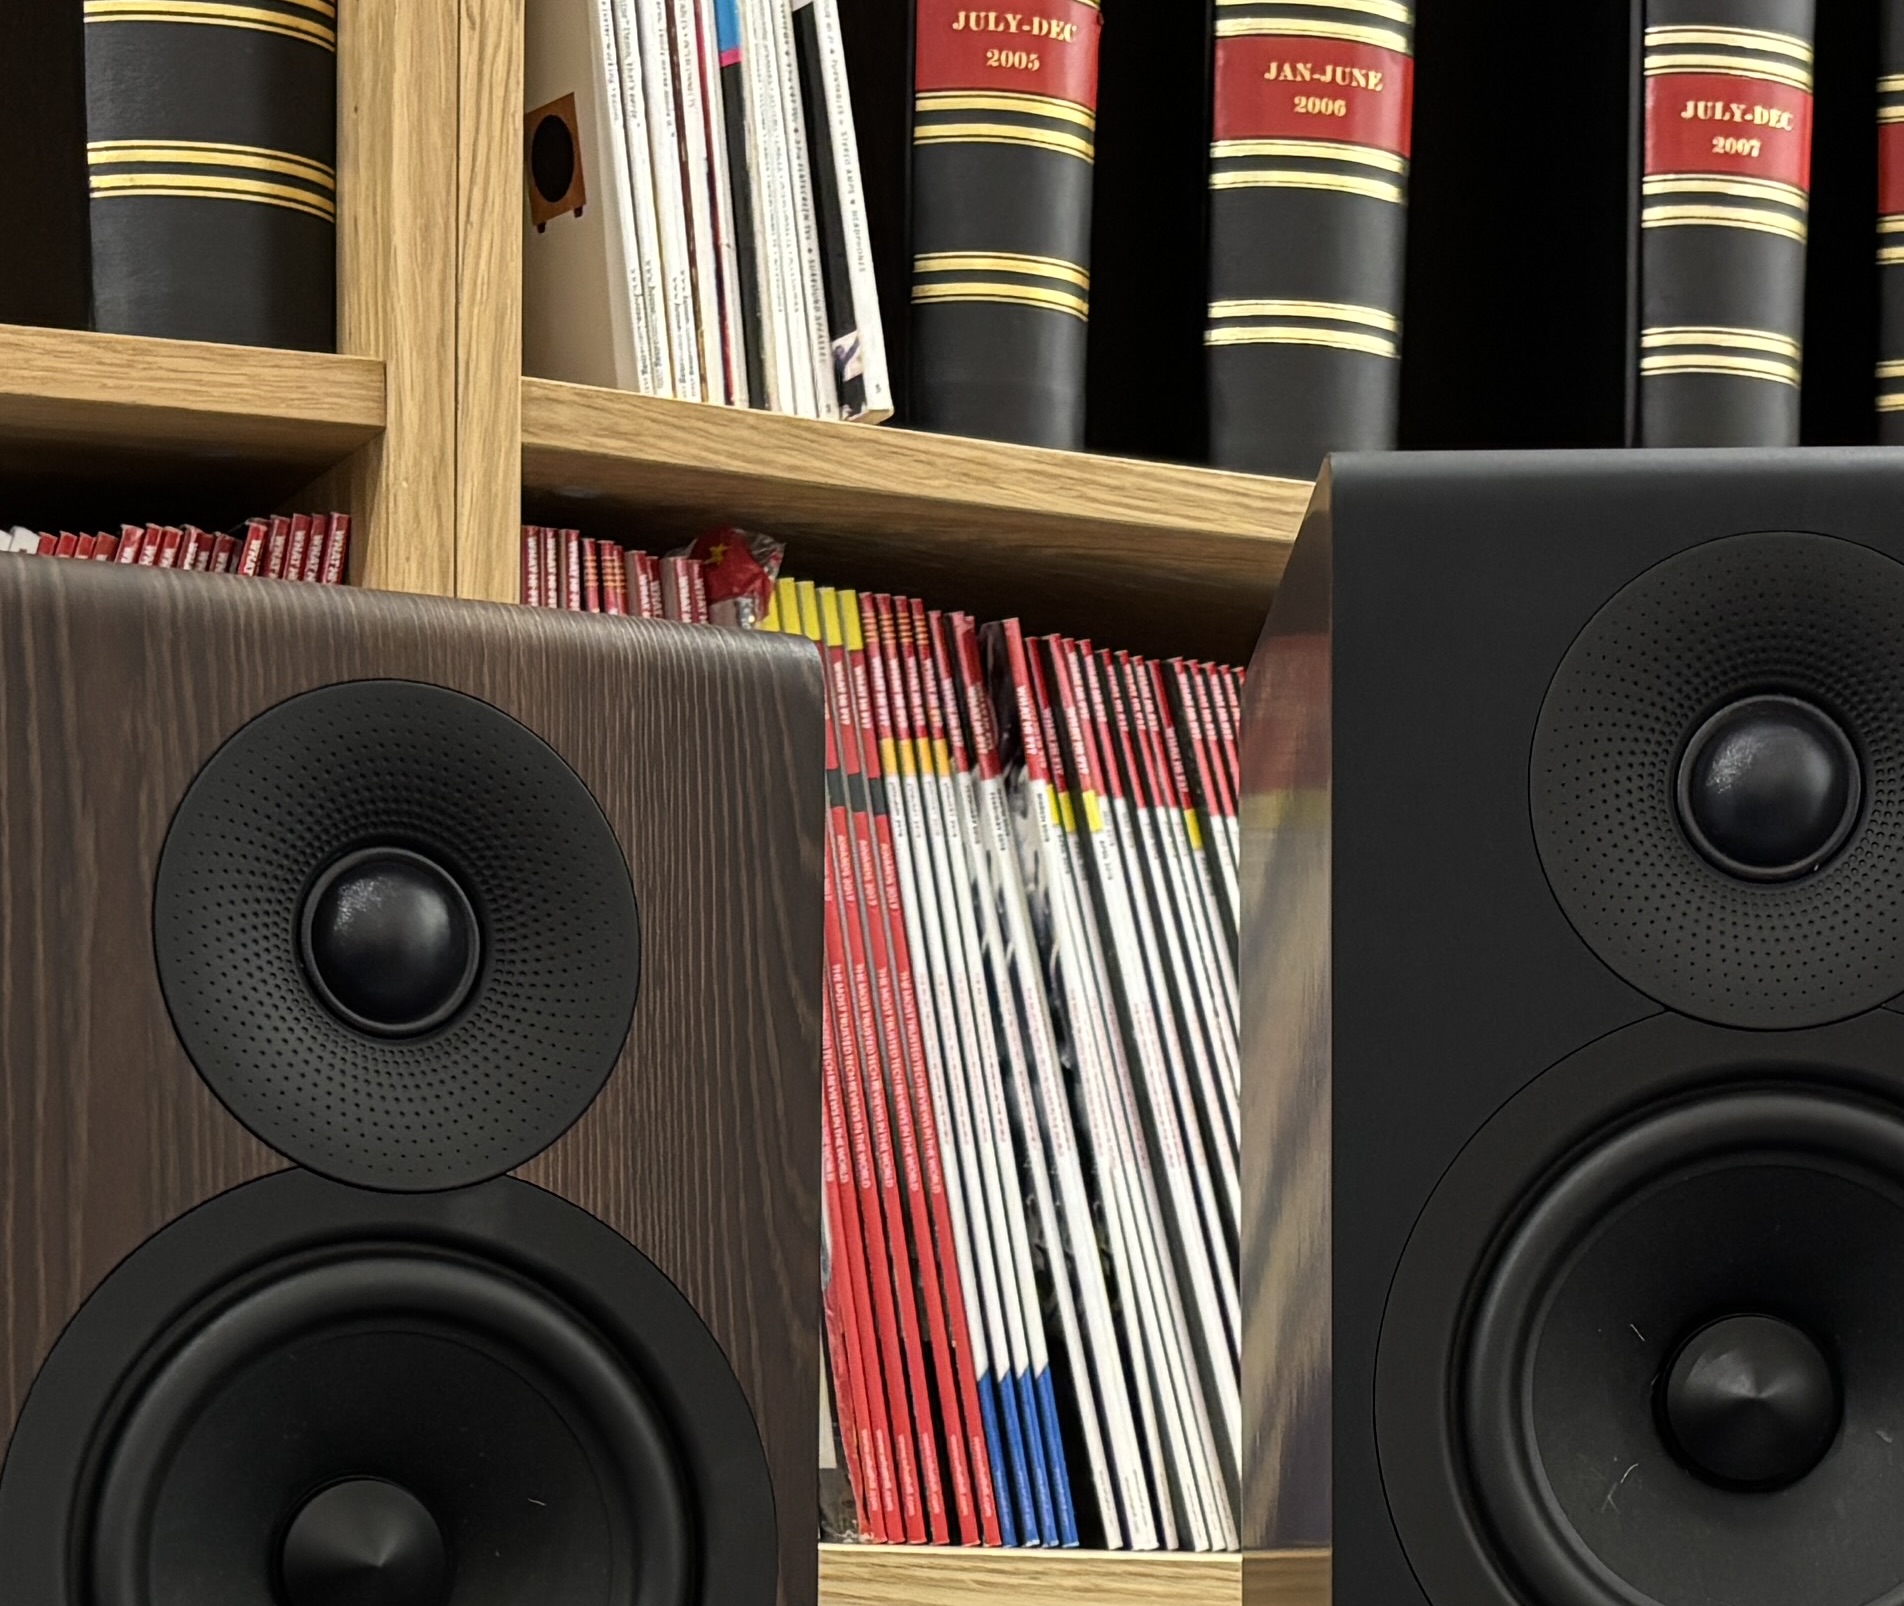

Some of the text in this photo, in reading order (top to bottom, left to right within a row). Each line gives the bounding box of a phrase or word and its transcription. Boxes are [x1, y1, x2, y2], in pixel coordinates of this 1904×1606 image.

[952, 11, 1077, 43] JULY-DEC
[986, 49, 1040, 71] 2005
[1264, 61, 1384, 92] JAN-JUNE
[1294, 96, 1346, 116] 2006
[1681, 101, 1793, 131] JULY-DEC
[1712, 137, 1762, 157] 2007
